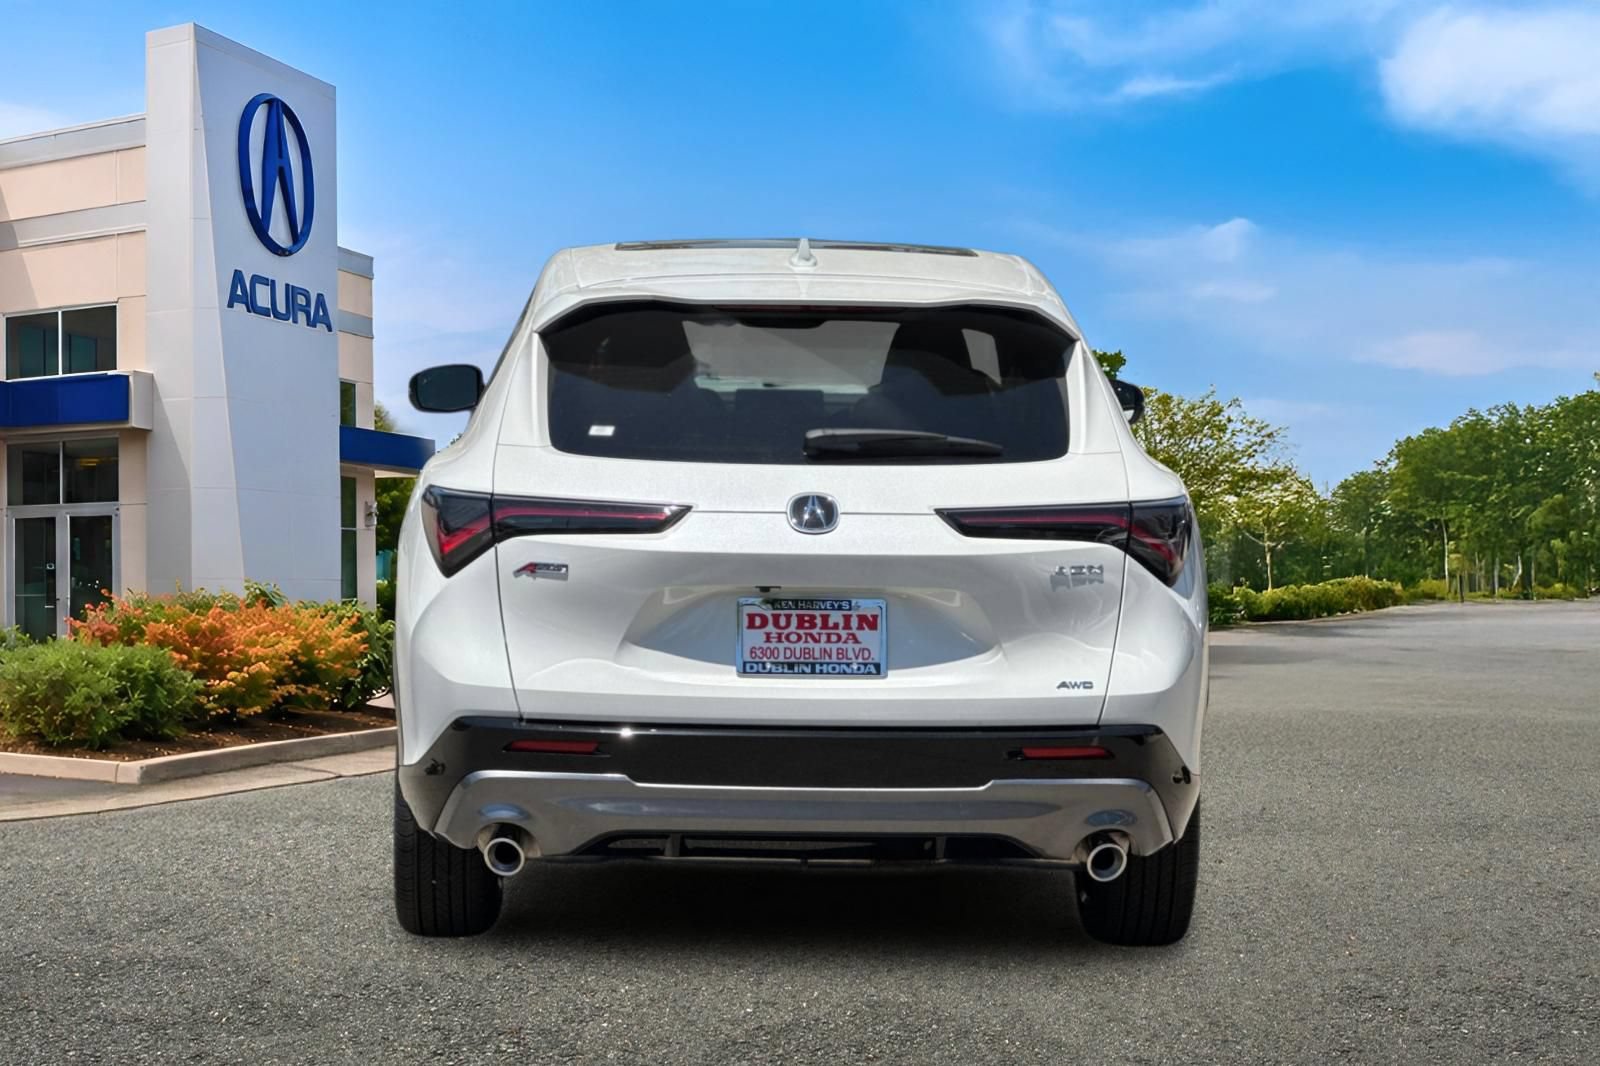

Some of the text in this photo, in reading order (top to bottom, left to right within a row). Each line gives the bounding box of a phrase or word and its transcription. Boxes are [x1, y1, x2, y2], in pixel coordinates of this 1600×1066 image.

[227, 269, 332, 332] ACURA
[798, 600, 850, 610] HARVEY'S
[746, 613, 879, 631] DUBLIN
[764, 632, 862, 644] HONDA
[750, 647, 875, 661] 6300 DUBLIN BLVD.
[745, 663, 877, 674] DUBLIN HONDA
[1056, 681, 1094, 690] AWD
